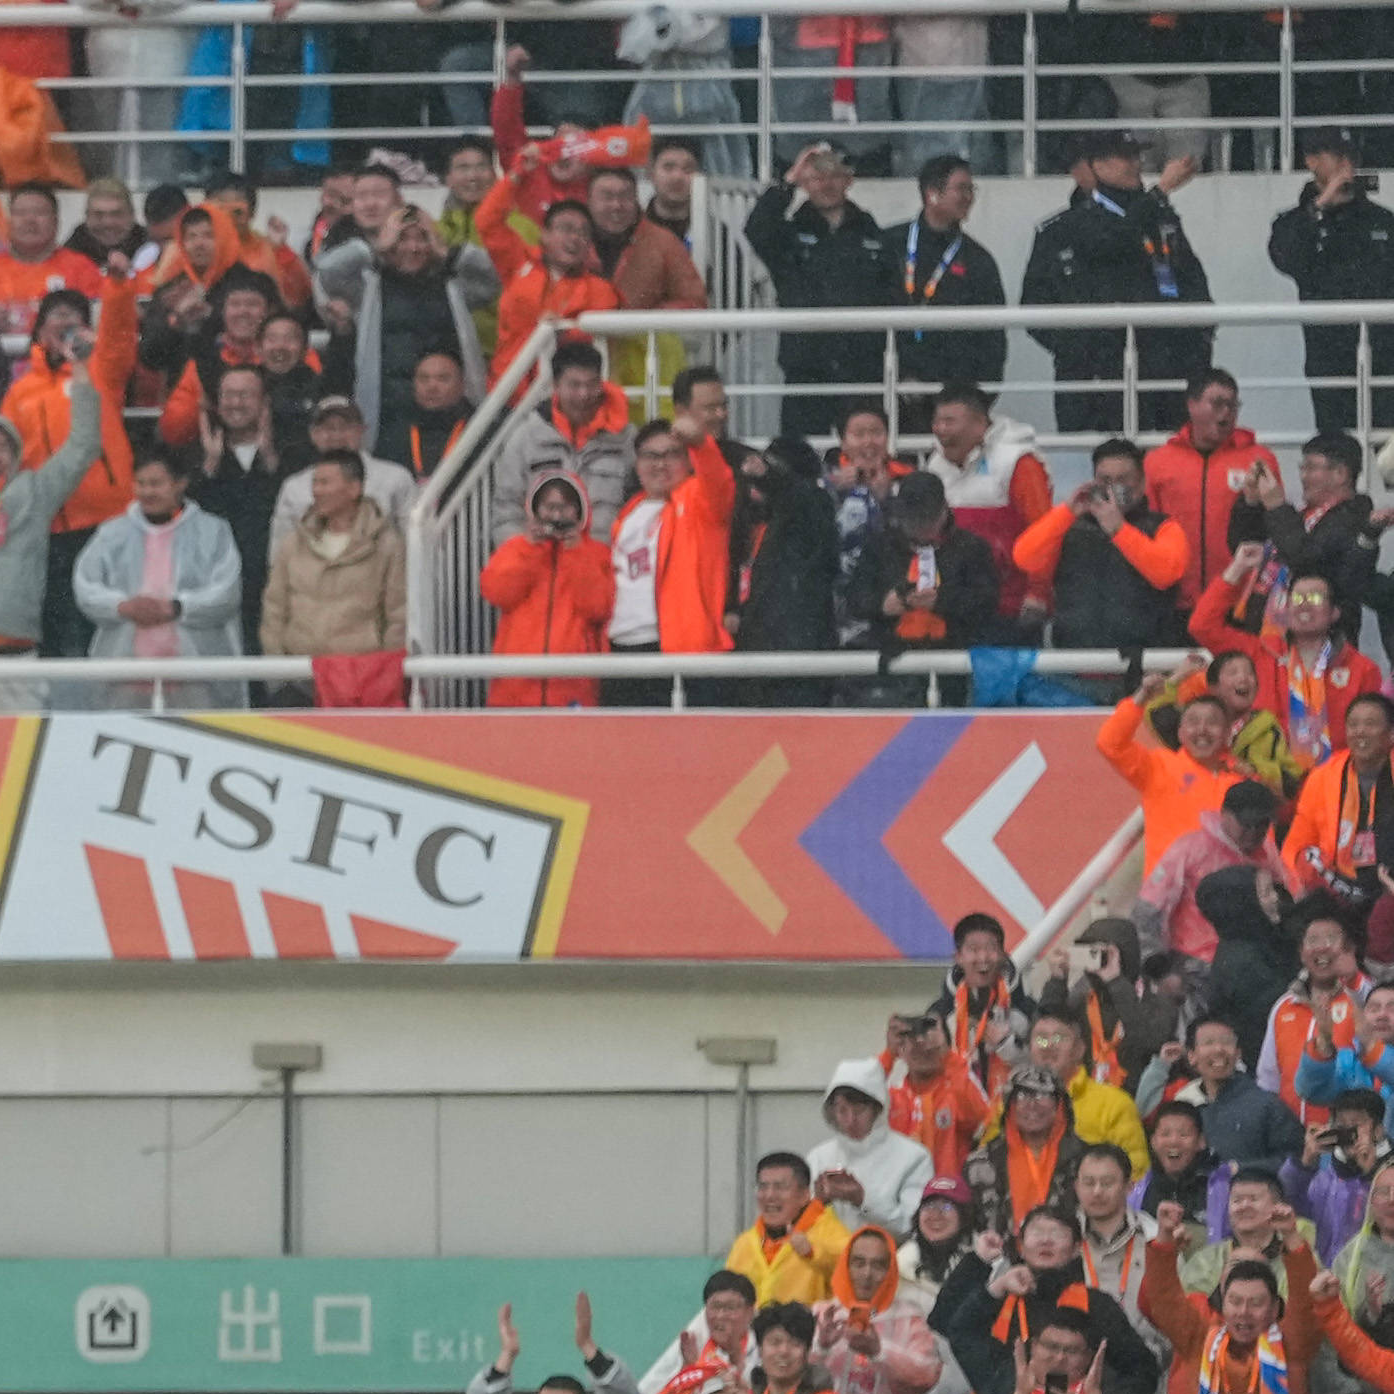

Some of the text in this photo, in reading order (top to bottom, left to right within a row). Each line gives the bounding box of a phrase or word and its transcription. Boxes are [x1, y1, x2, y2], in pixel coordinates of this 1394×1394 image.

[91, 733, 498, 909] TSFC
[218, 1285, 373, 1364] 出口
[414, 1330, 485, 1363] Exit
